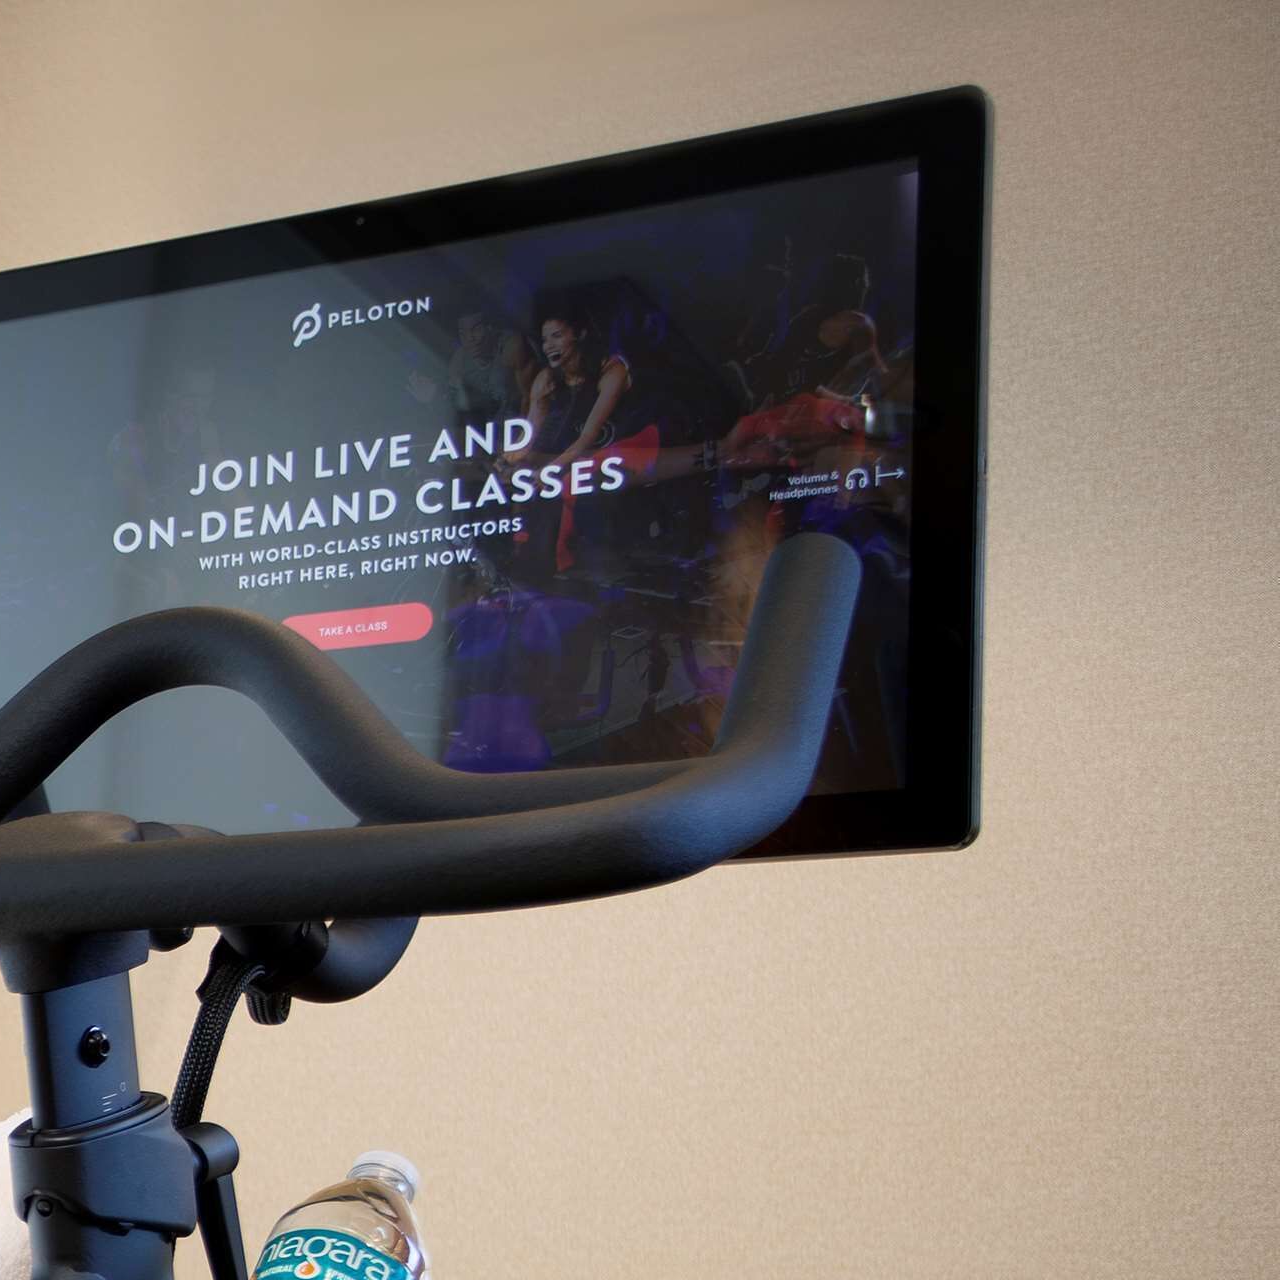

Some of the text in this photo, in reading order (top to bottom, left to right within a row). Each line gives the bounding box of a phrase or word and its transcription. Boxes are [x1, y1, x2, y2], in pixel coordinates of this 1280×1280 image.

[328, 296, 431, 329] PELOTON
[190, 417, 534, 497] JOIN LIVE AND
[769, 484, 839, 501] Headphones
[788, 471, 839, 487] Volume &
[112, 456, 626, 554] ON-DEMAND CLASSES
[198, 516, 523, 572] WITH WORLD-CLASS INSTRUCTORS
[238, 547, 477, 590] RIGHT HERE, RIGHT NOW.
[318, 621, 389, 637] TAKE A CLASS
